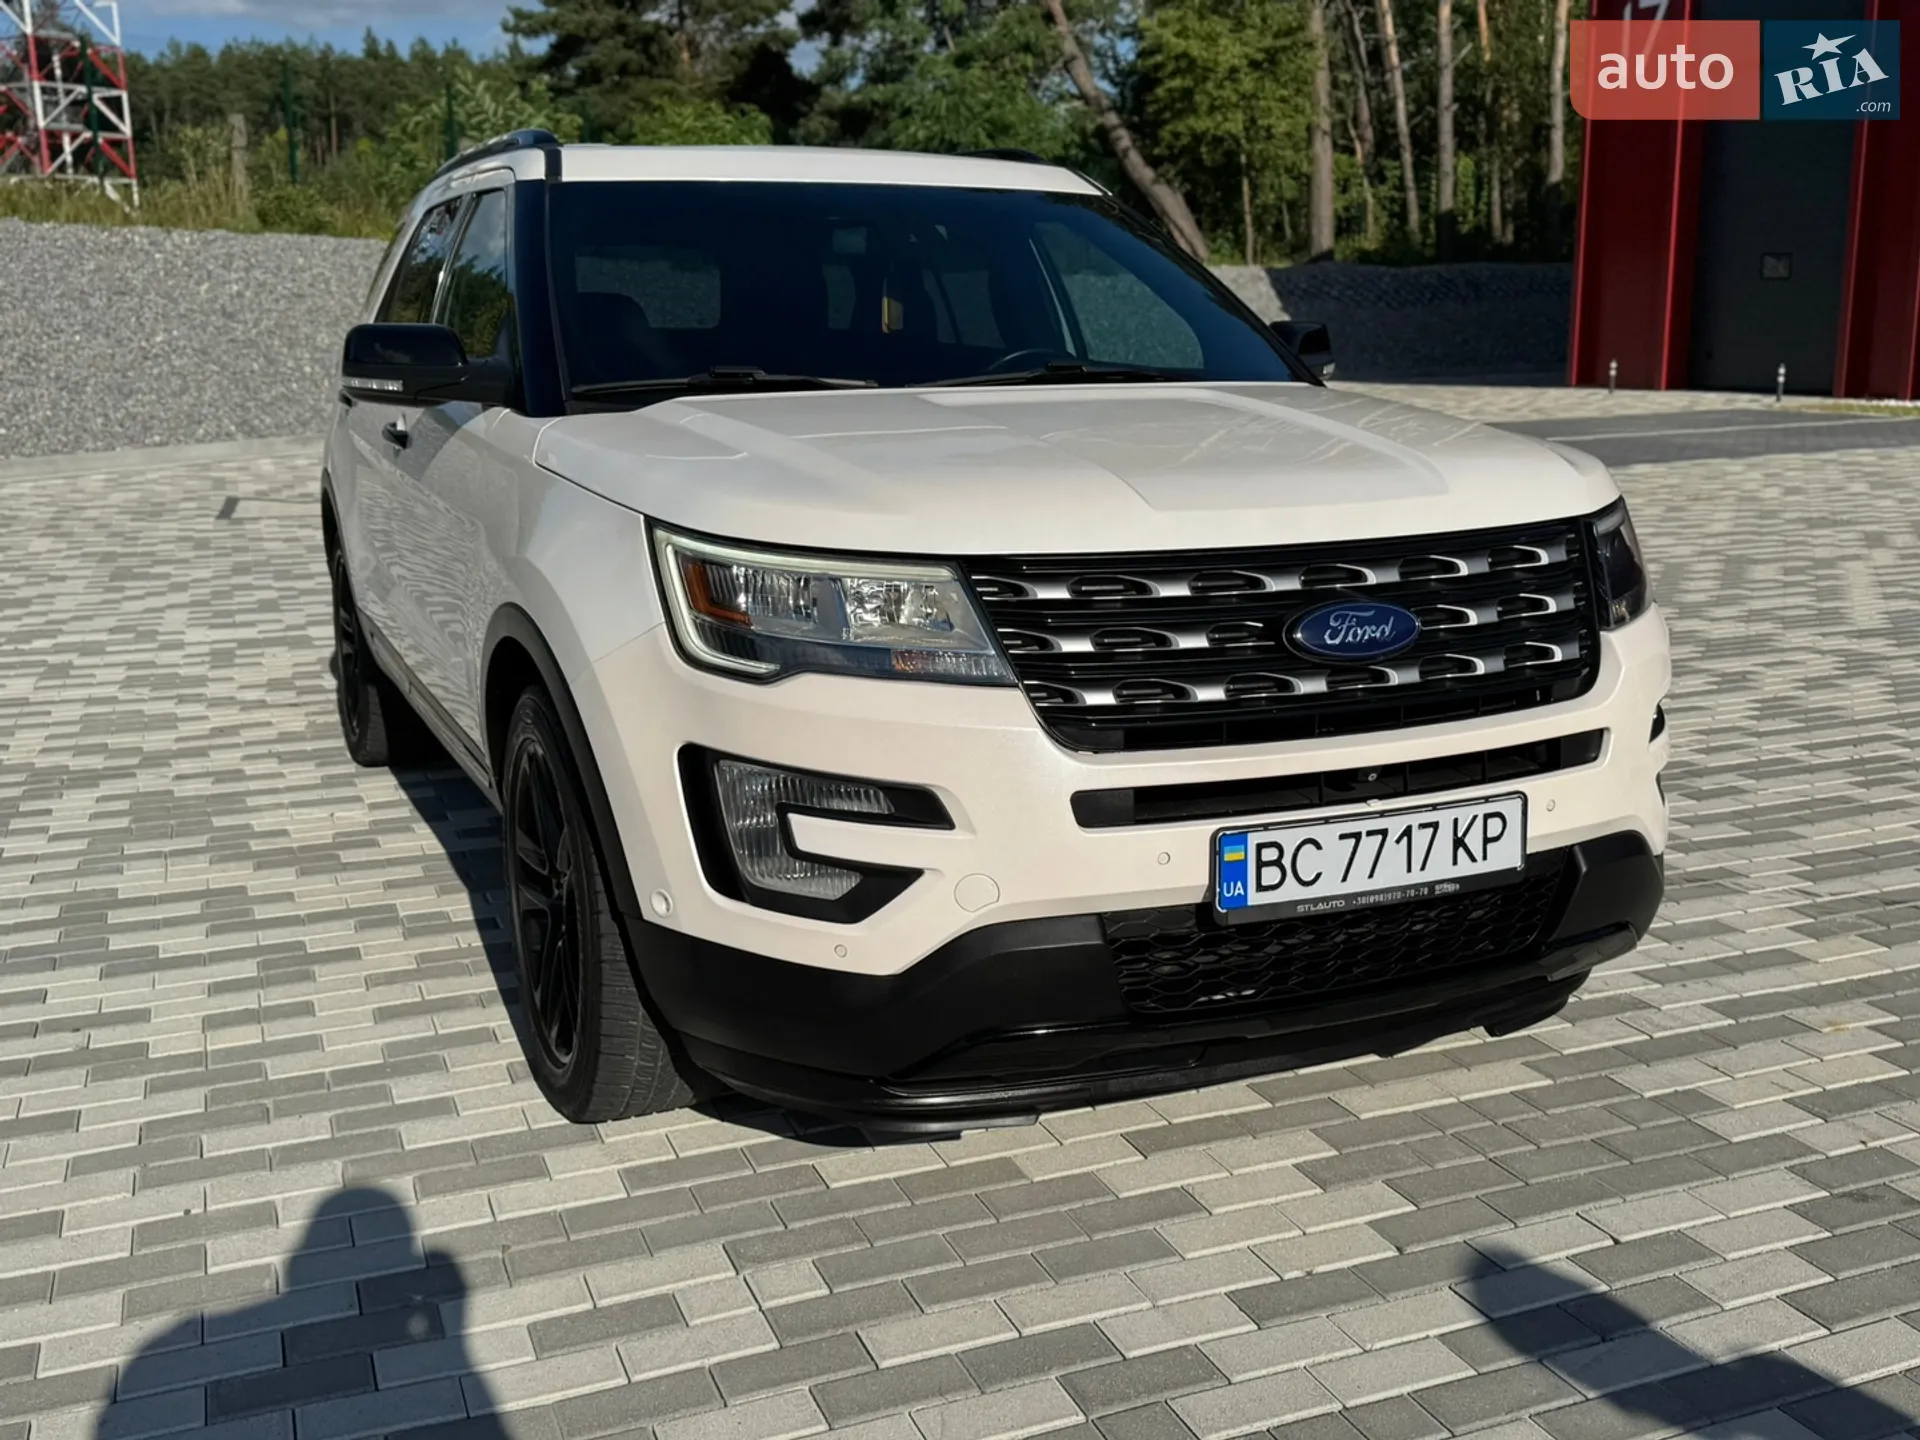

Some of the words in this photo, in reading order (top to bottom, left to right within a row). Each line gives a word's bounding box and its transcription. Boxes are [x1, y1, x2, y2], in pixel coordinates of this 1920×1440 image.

[1324, 610, 1396, 645] Ford
[1255, 837, 1323, 893] BC
[1338, 820, 1440, 883] 7717
[1452, 811, 1508, 867] KP
[1223, 880, 1245, 897] UA
